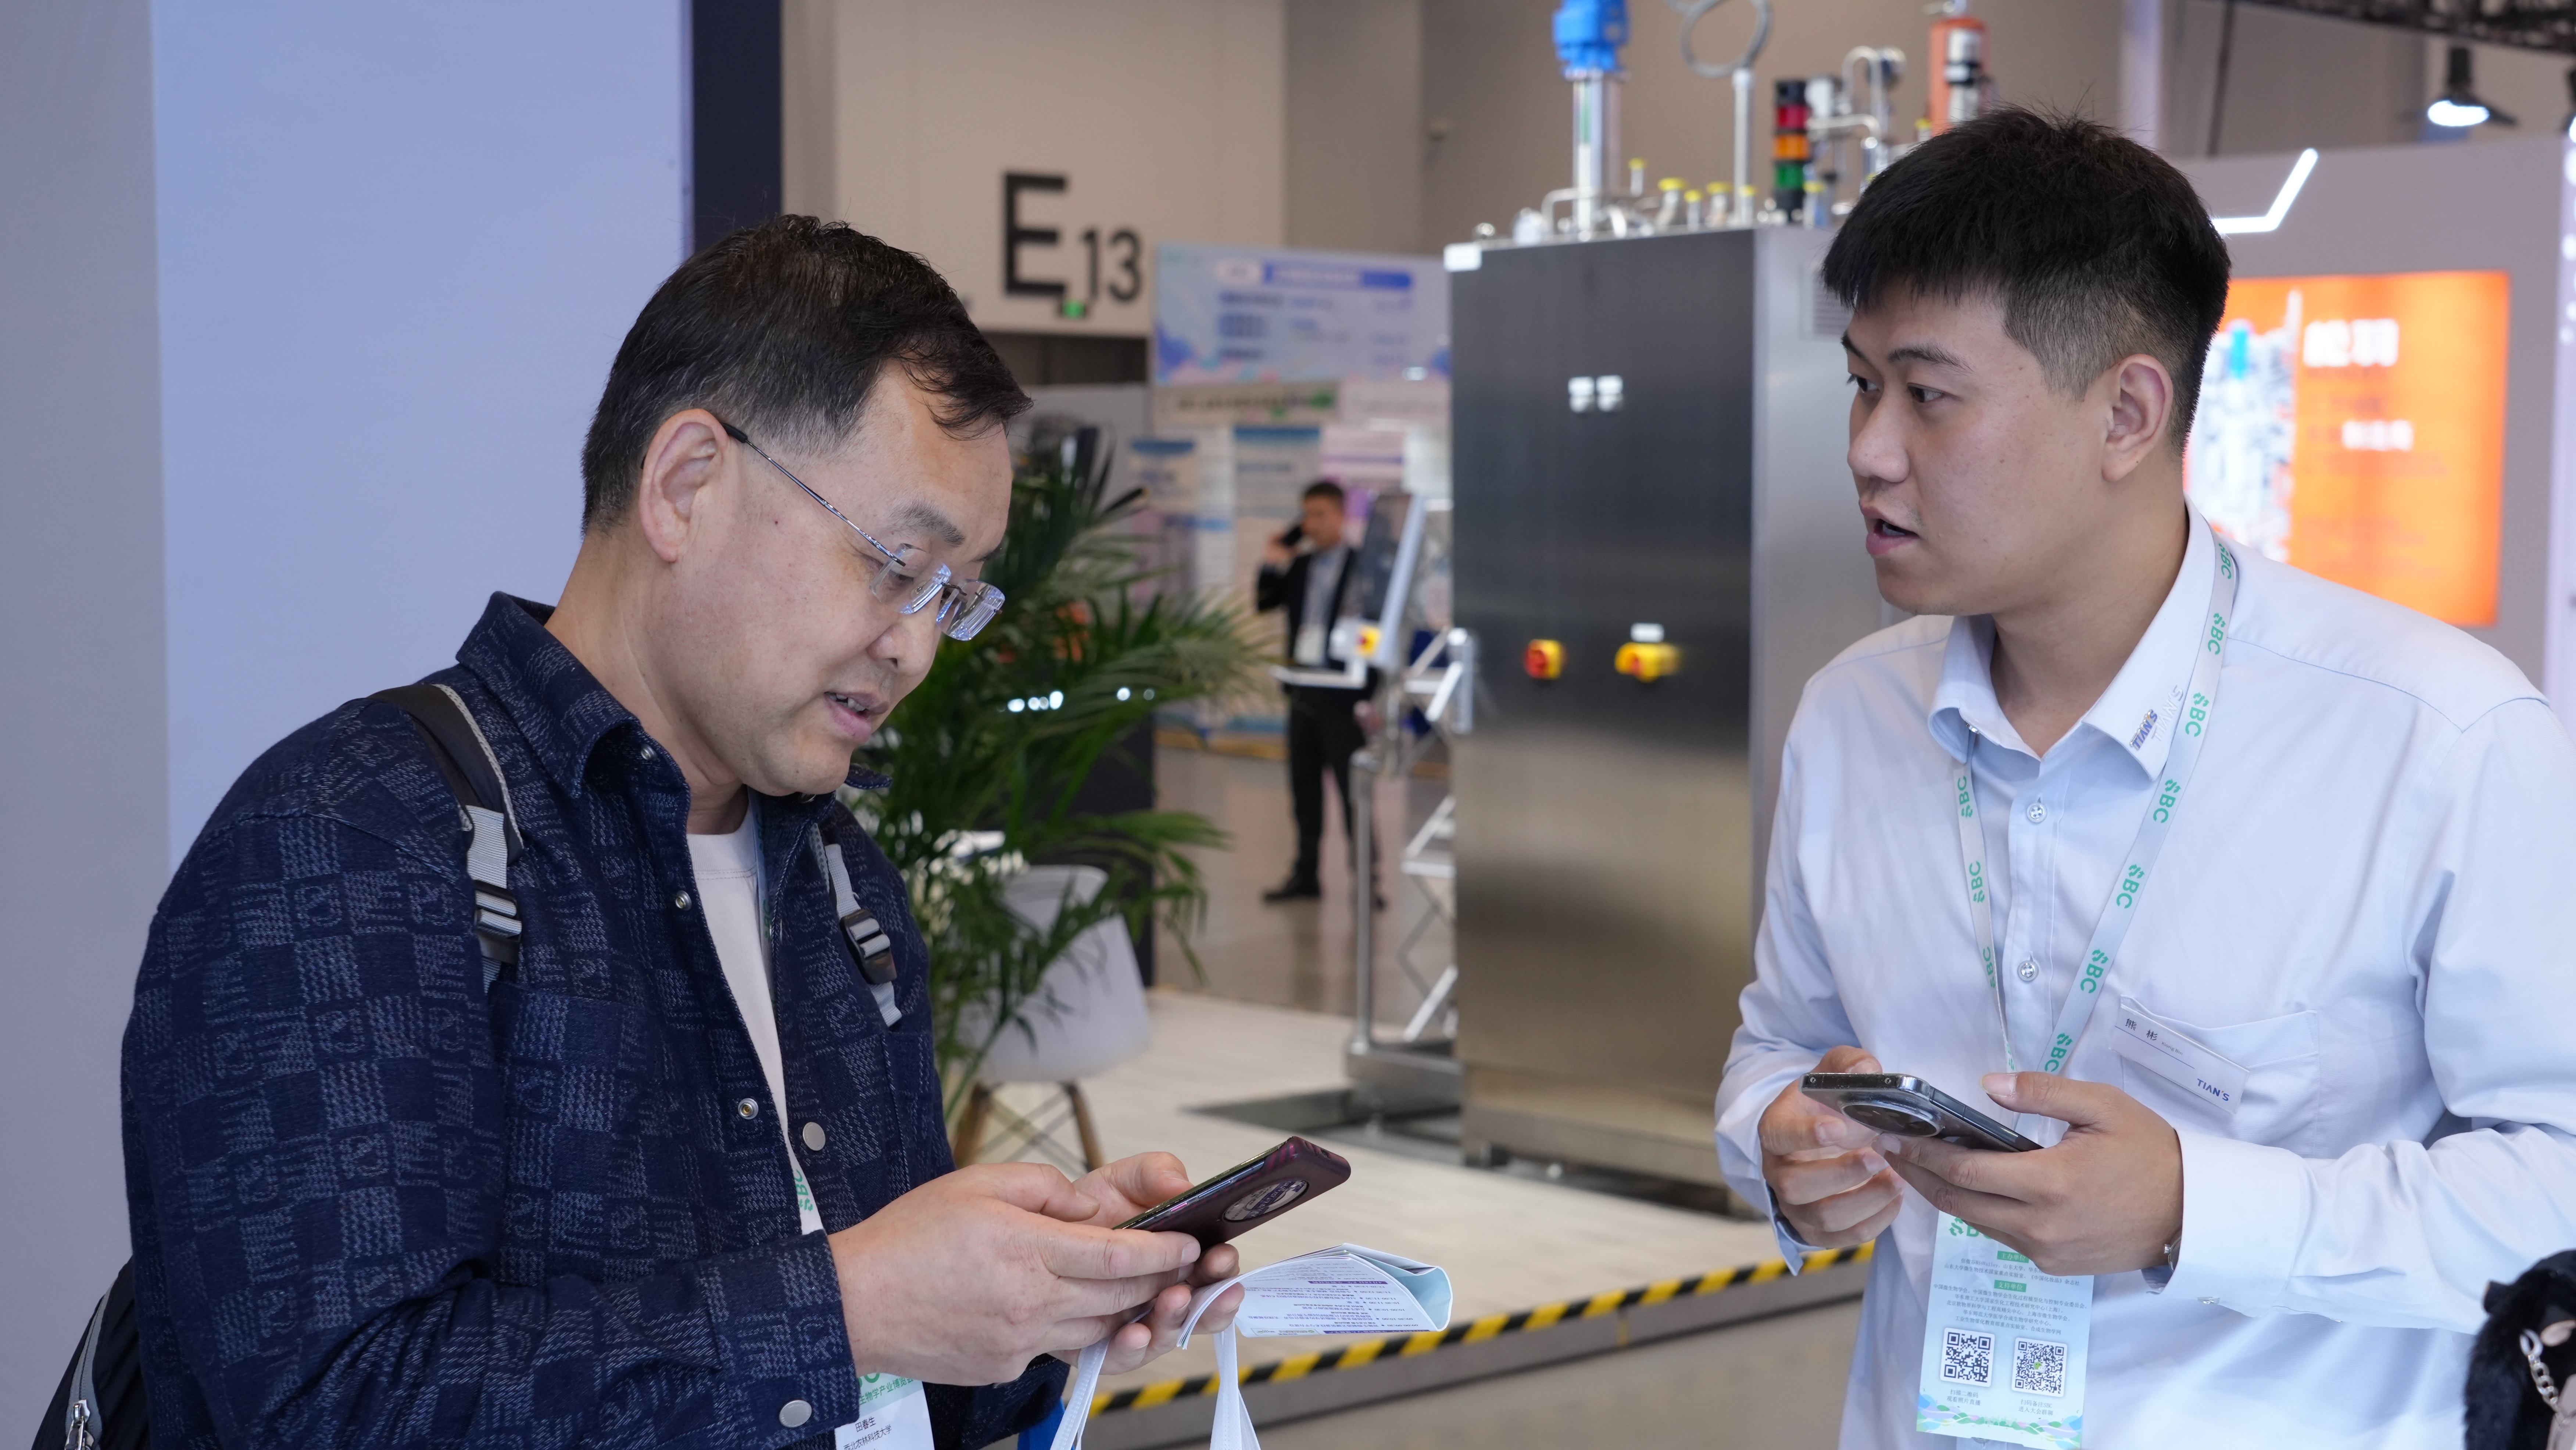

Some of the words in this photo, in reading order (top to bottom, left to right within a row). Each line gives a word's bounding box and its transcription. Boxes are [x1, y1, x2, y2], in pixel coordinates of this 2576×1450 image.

[2125, 1018, 2137, 1031] 熊
[2146, 1029, 2158, 1041] 彬
[2161, 1041, 2175, 1052] Xiong
[2197, 1078, 2230, 1101] TIAN'S
[1999, 1281, 2022, 1290] 支持单位
[1950, 1389, 1979, 1399] 扫描二维码
[1947, 1396, 1981, 1406] 观看照片直播
[2021, 1399, 2053, 1408] 扫码备注SBC
[2018, 1406, 2054, 1416] 进入大会群聊
[855, 1416, 876, 1432] 田春生
[843, 1424, 892, 1450] 西北农林科技大学
